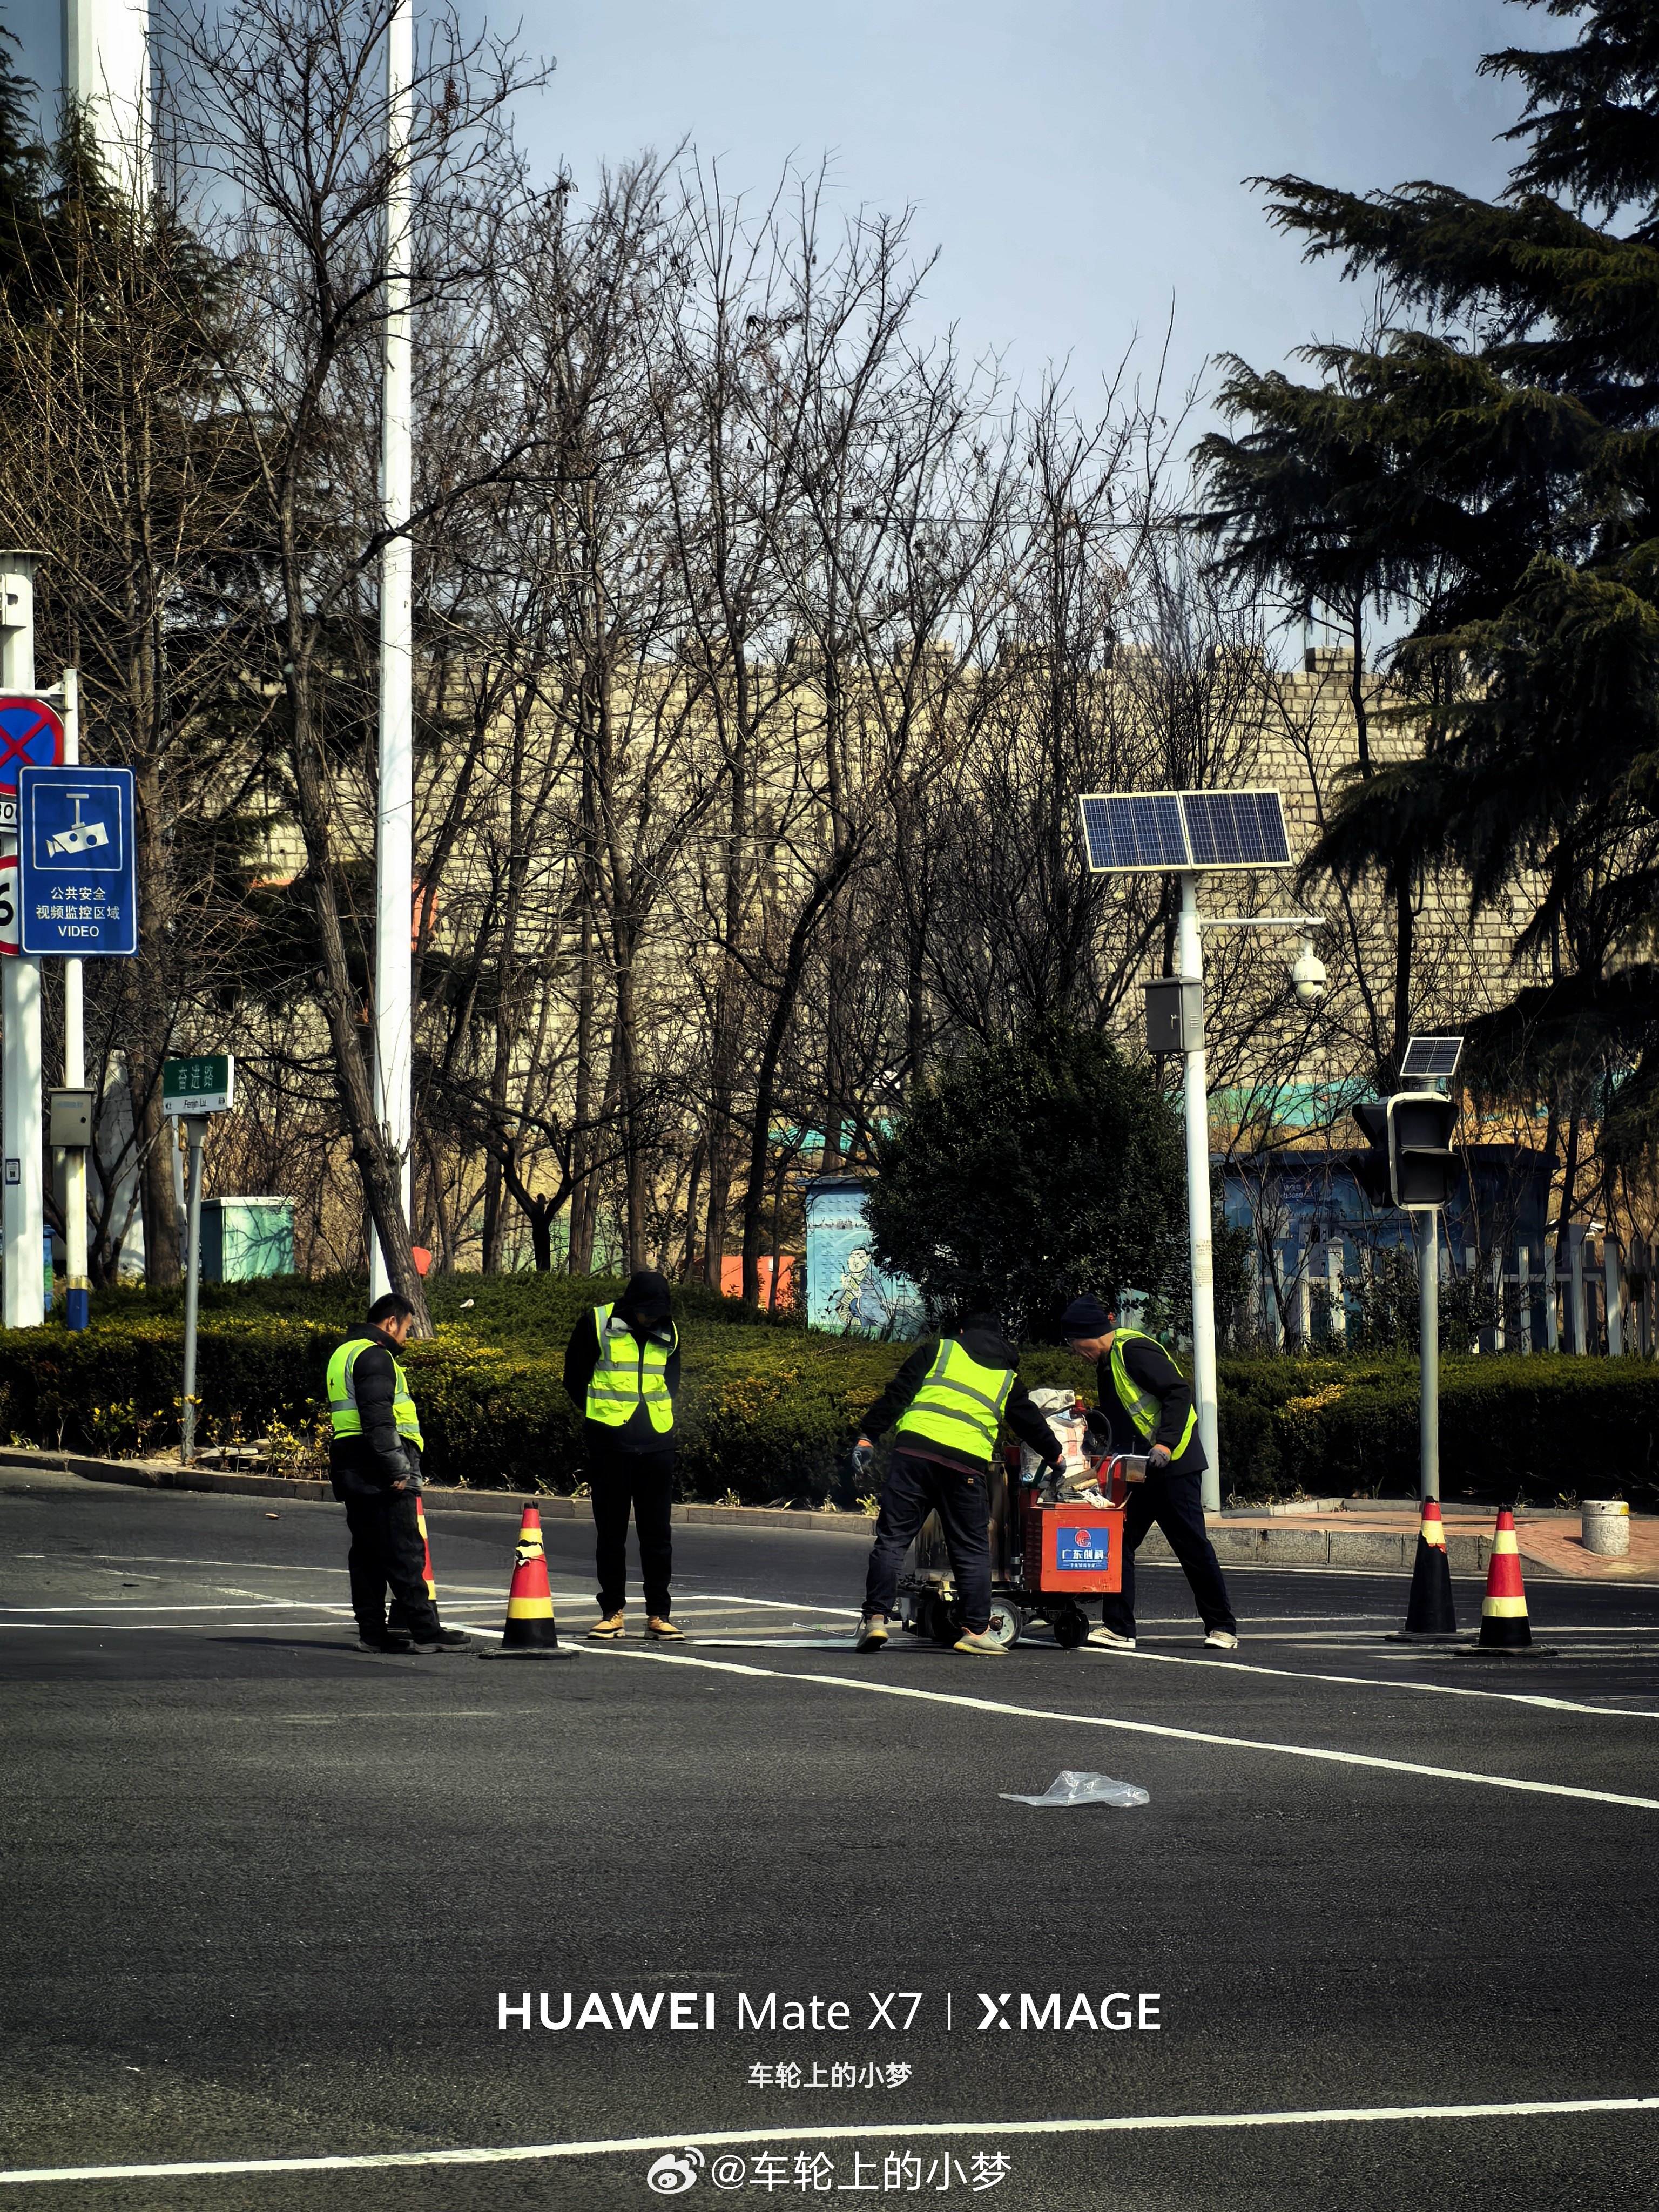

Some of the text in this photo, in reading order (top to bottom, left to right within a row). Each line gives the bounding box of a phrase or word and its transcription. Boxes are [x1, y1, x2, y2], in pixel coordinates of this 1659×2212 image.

[51, 886, 106, 901] 公共安全
[36, 905, 120, 920] 视频监控区域
[58, 925, 99, 937] VIDEO
[178, 1064, 214, 1090] 奋进路
